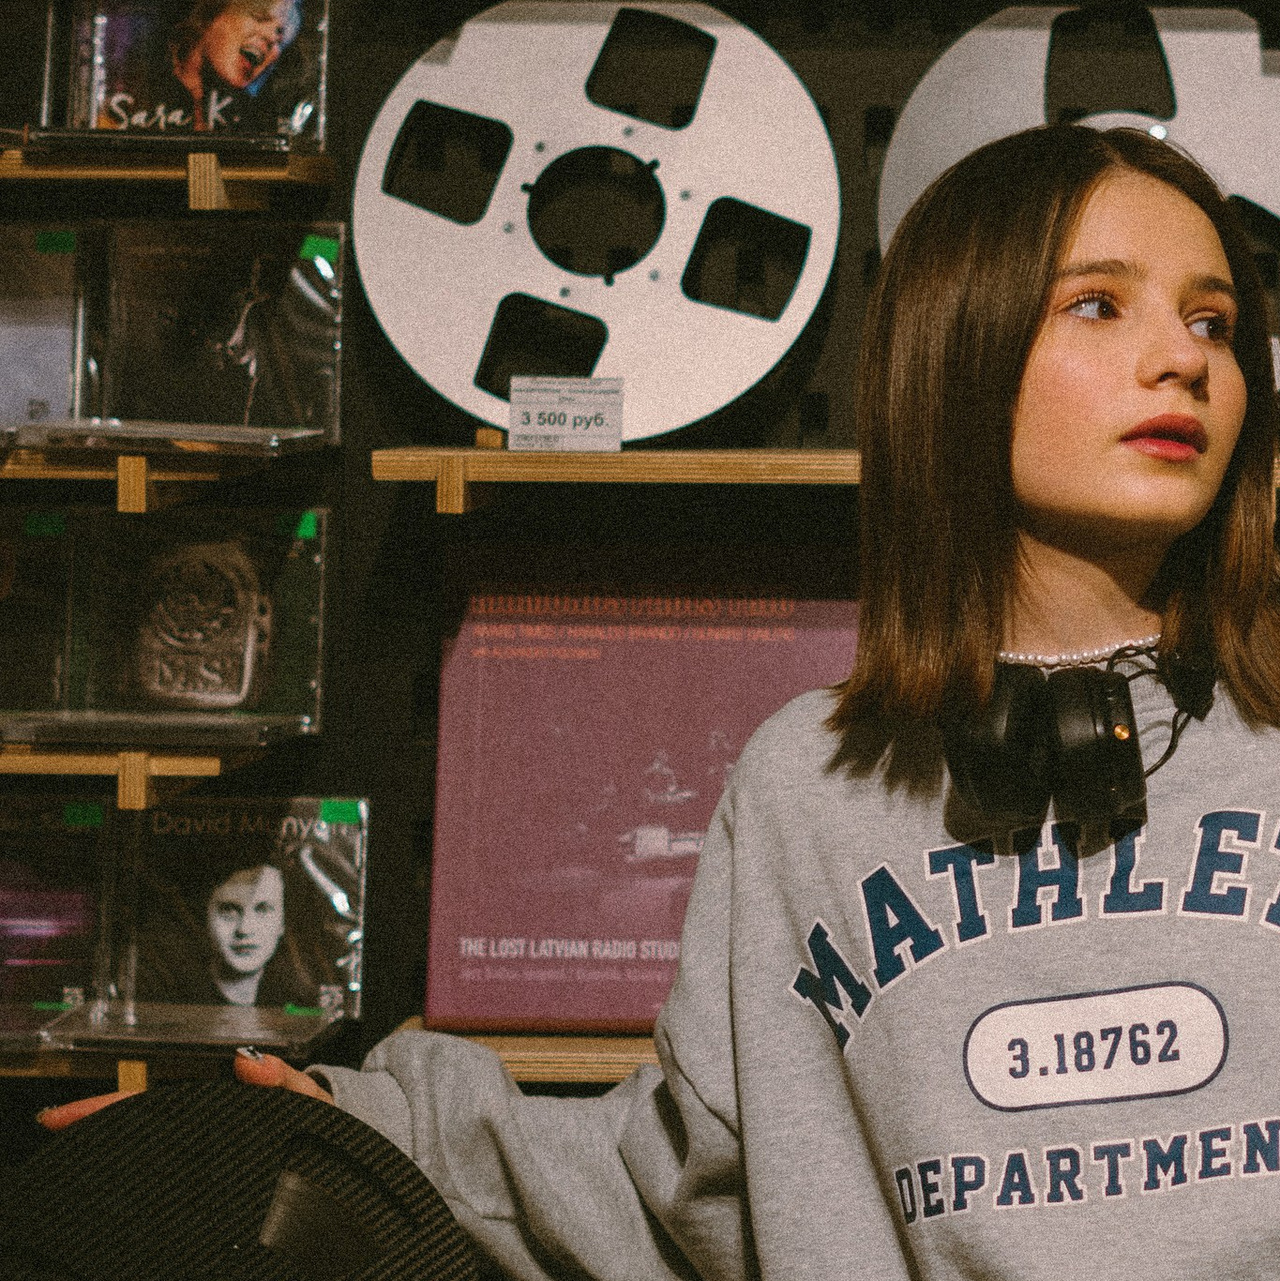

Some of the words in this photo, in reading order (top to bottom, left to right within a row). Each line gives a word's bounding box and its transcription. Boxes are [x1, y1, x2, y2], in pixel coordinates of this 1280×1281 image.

[109, 93, 190, 129] Sara
[208, 90, 241, 128] K.
[521, 411, 531, 426] 3
[537, 411, 568, 427] 500
[572, 412, 610, 431] руб.
[152, 811, 232, 836] David
[459, 936, 486, 958] THE
[489, 937, 526, 959] LOST
[528, 938, 589, 959] LATVIAN
[591, 939, 637, 960] RADIO
[1007, 1020, 1181, 1081] 3.18762
